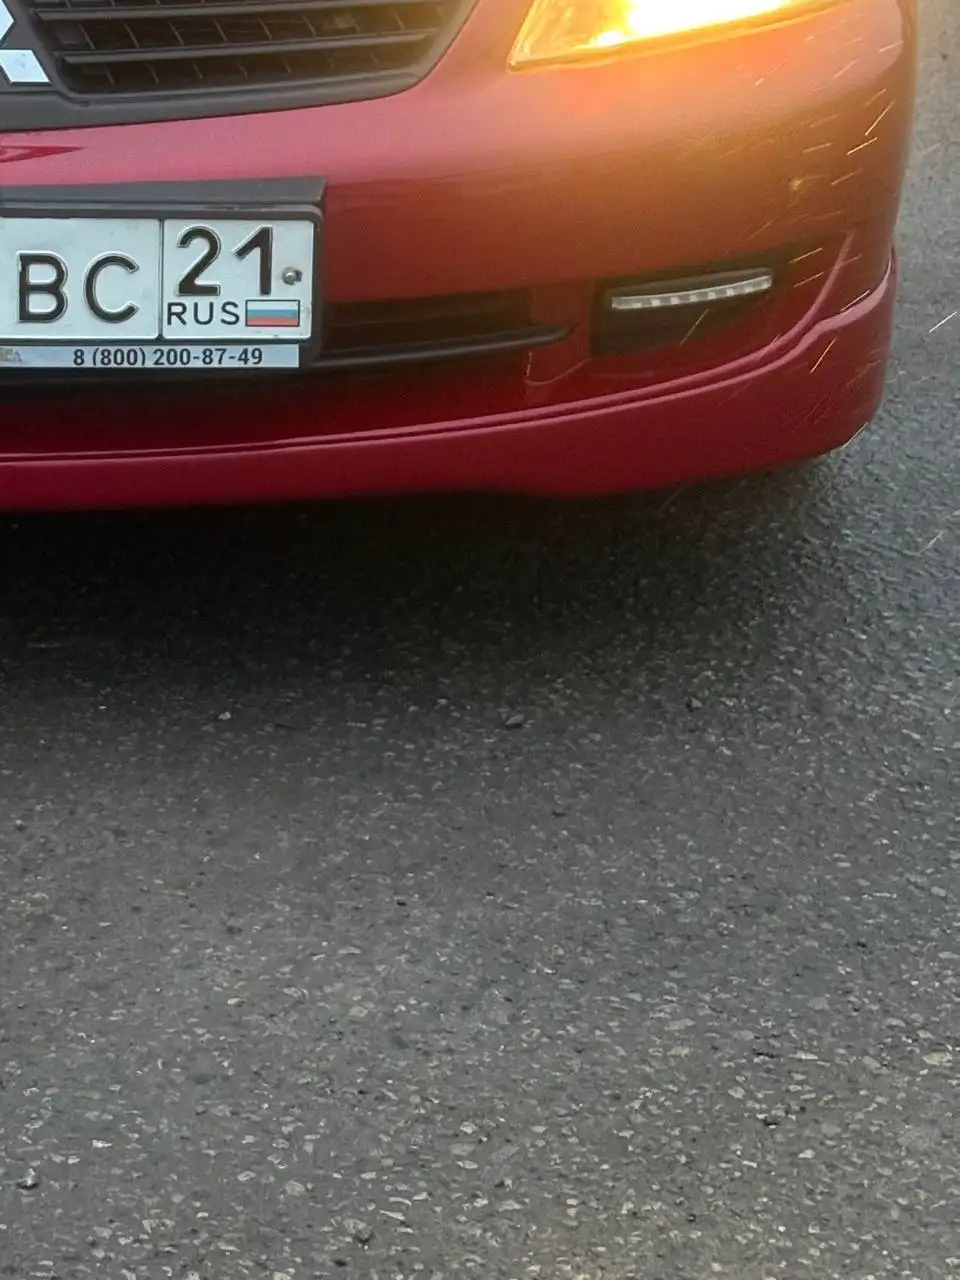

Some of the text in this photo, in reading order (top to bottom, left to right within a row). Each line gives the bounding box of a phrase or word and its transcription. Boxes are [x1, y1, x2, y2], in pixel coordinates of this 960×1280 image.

[177, 225, 273, 297] 21
[166, 301, 240, 326] RUS
[72, 348, 263, 367] 8 (800) 200-87-49
